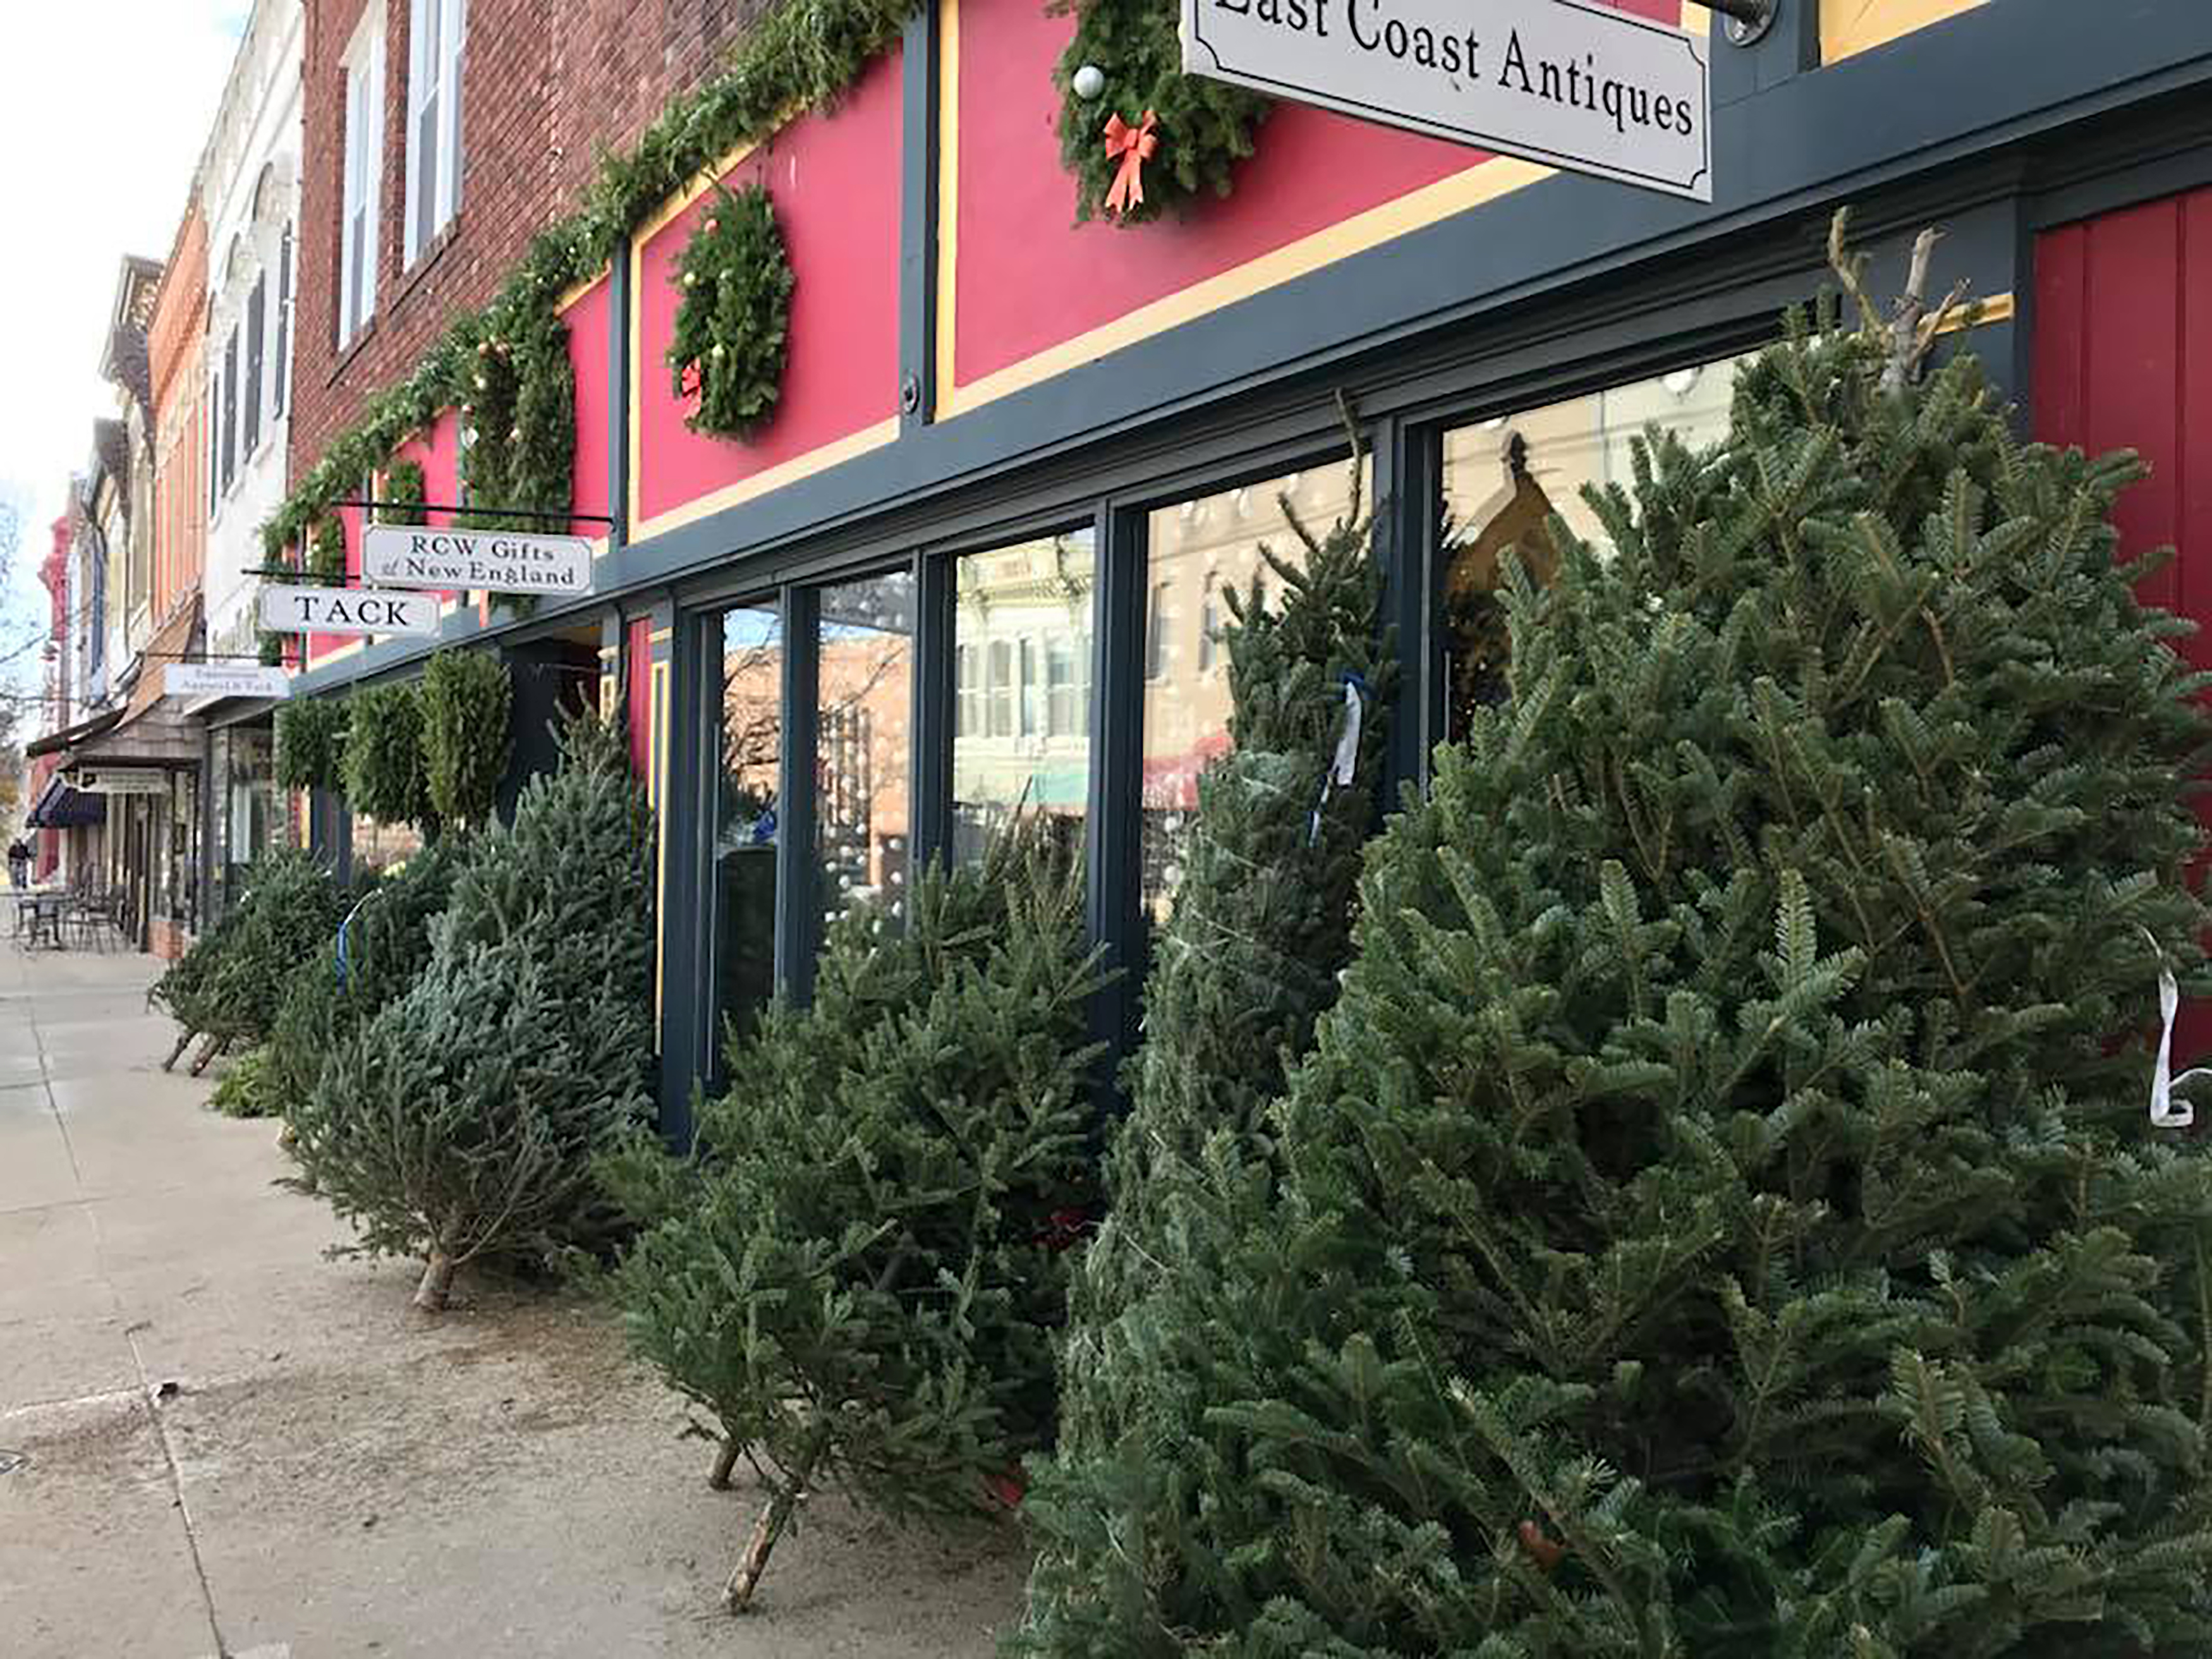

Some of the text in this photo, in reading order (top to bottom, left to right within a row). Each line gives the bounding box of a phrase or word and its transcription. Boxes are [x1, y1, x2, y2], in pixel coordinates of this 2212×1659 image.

[1215, 0, 1692, 135] ast Coast Antiques
[411, 535, 554, 561] RCW Gifts
[406, 558, 461, 580] New
[469, 561, 574, 585] England
[295, 597, 408, 626] TACK
